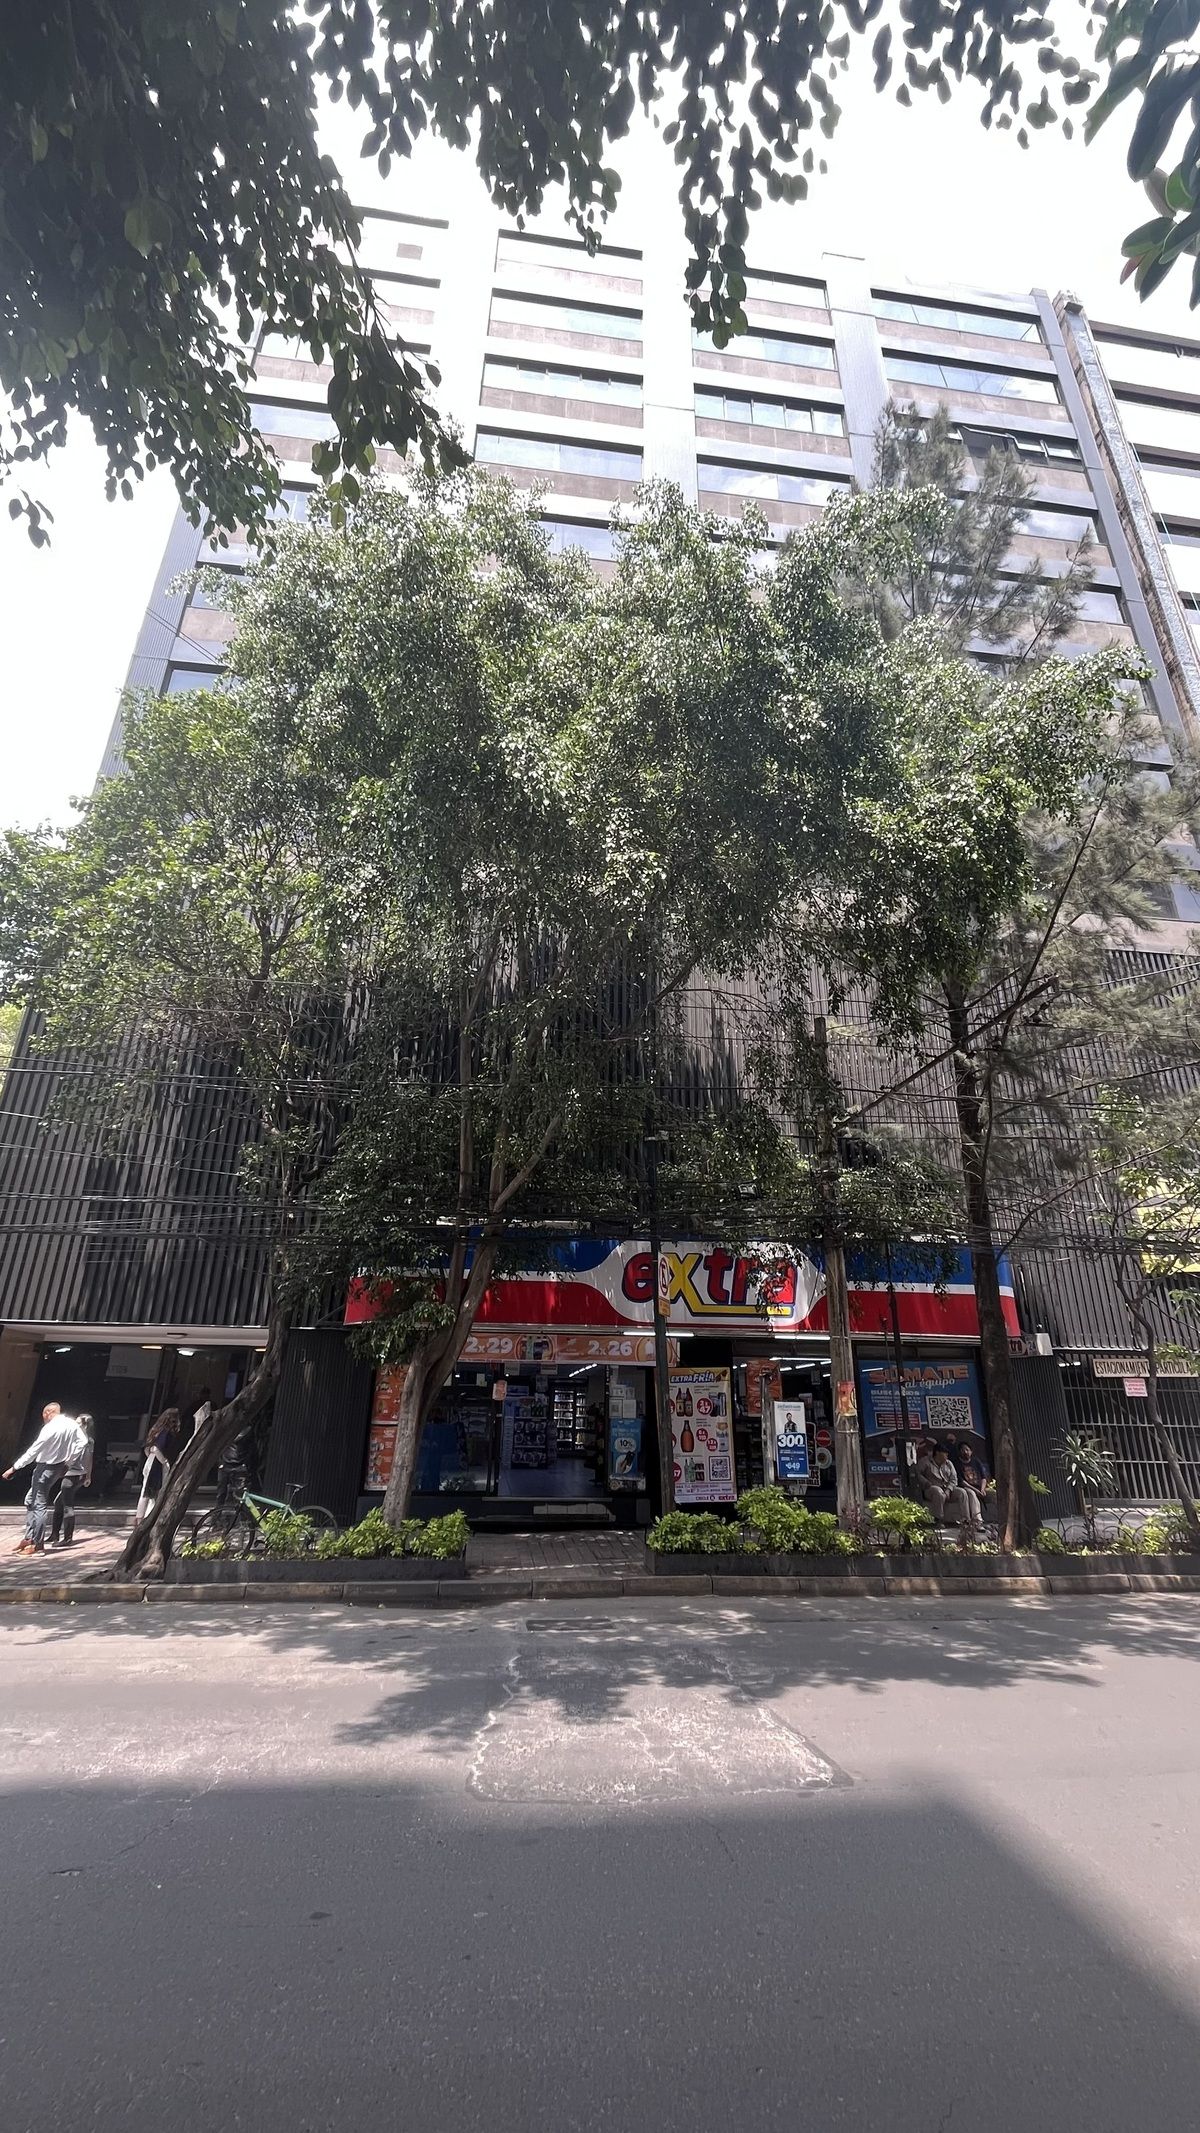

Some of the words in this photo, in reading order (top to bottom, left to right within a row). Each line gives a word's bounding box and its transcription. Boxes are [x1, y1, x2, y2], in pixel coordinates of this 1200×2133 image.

[621, 1247, 797, 1314] extra
[465, 1337, 513, 1354] 2x29
[588, 1340, 633, 1356] 2x26
[1095, 1361, 1150, 1374] ESTACIONAMIENT
[1156, 1361, 1192, 1374] PARTICULA
[904, 1378, 917, 1388] al
[778, 1434, 804, 1447] 300
